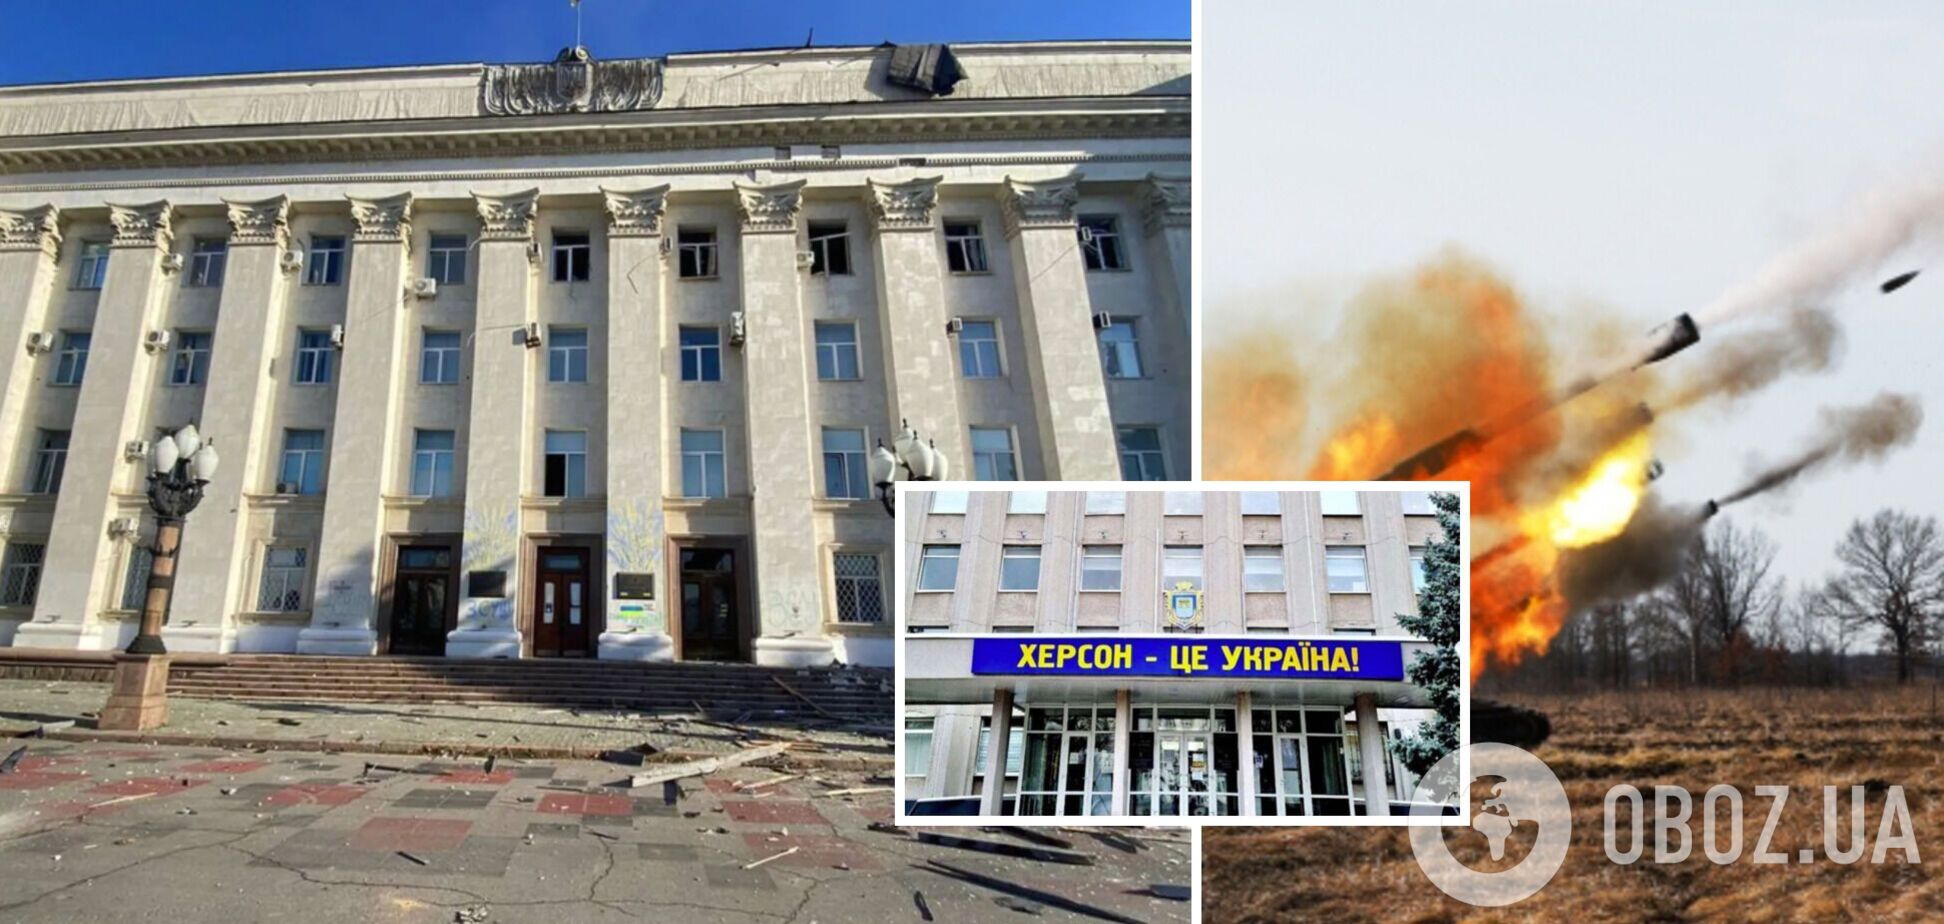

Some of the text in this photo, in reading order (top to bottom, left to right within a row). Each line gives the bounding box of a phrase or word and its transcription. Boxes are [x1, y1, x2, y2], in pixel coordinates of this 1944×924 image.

[1017, 644, 1132, 669] ХЕРСОН
[1170, 645, 1209, 674] ЦЕ
[1220, 641, 1360, 672] УКРАЇНА!
